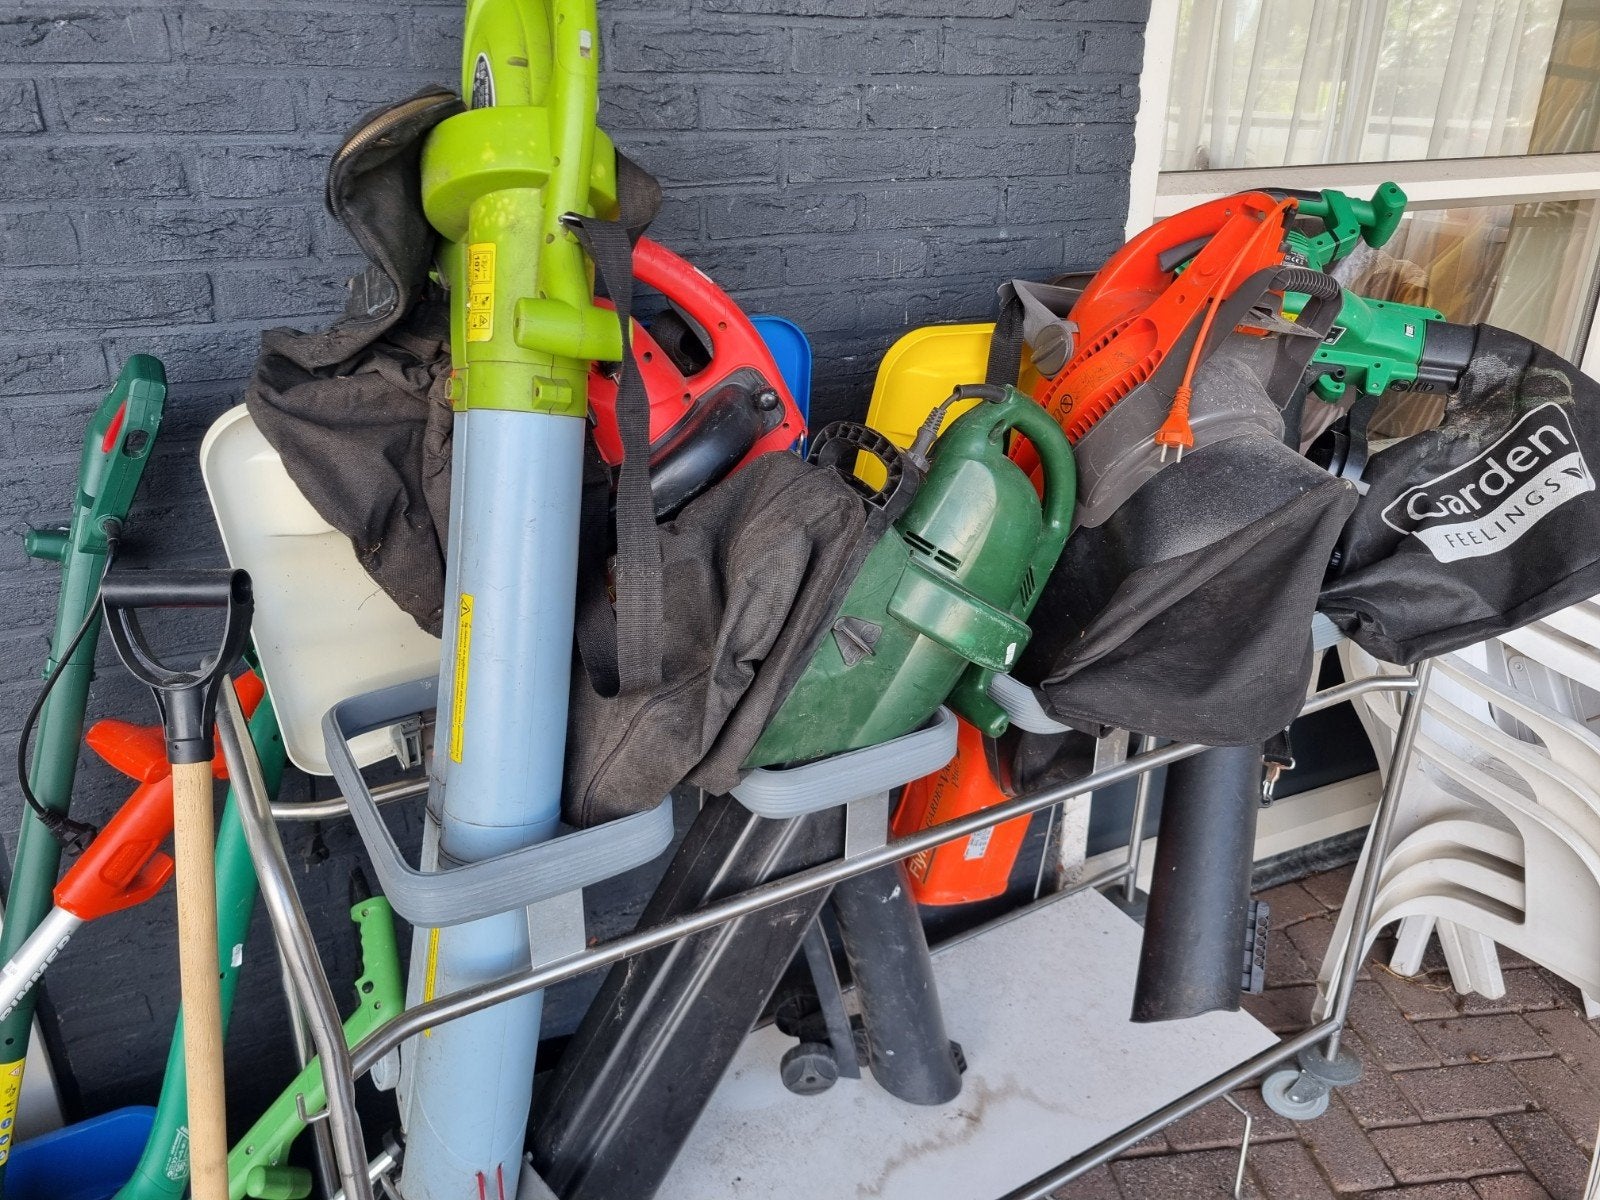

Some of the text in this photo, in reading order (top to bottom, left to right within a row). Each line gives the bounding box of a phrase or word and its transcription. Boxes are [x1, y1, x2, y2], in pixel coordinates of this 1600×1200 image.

[1406, 424, 1570, 521] Garden
[1444, 477, 1561, 548] FEELINGS
[909, 849, 928, 878] Fly
